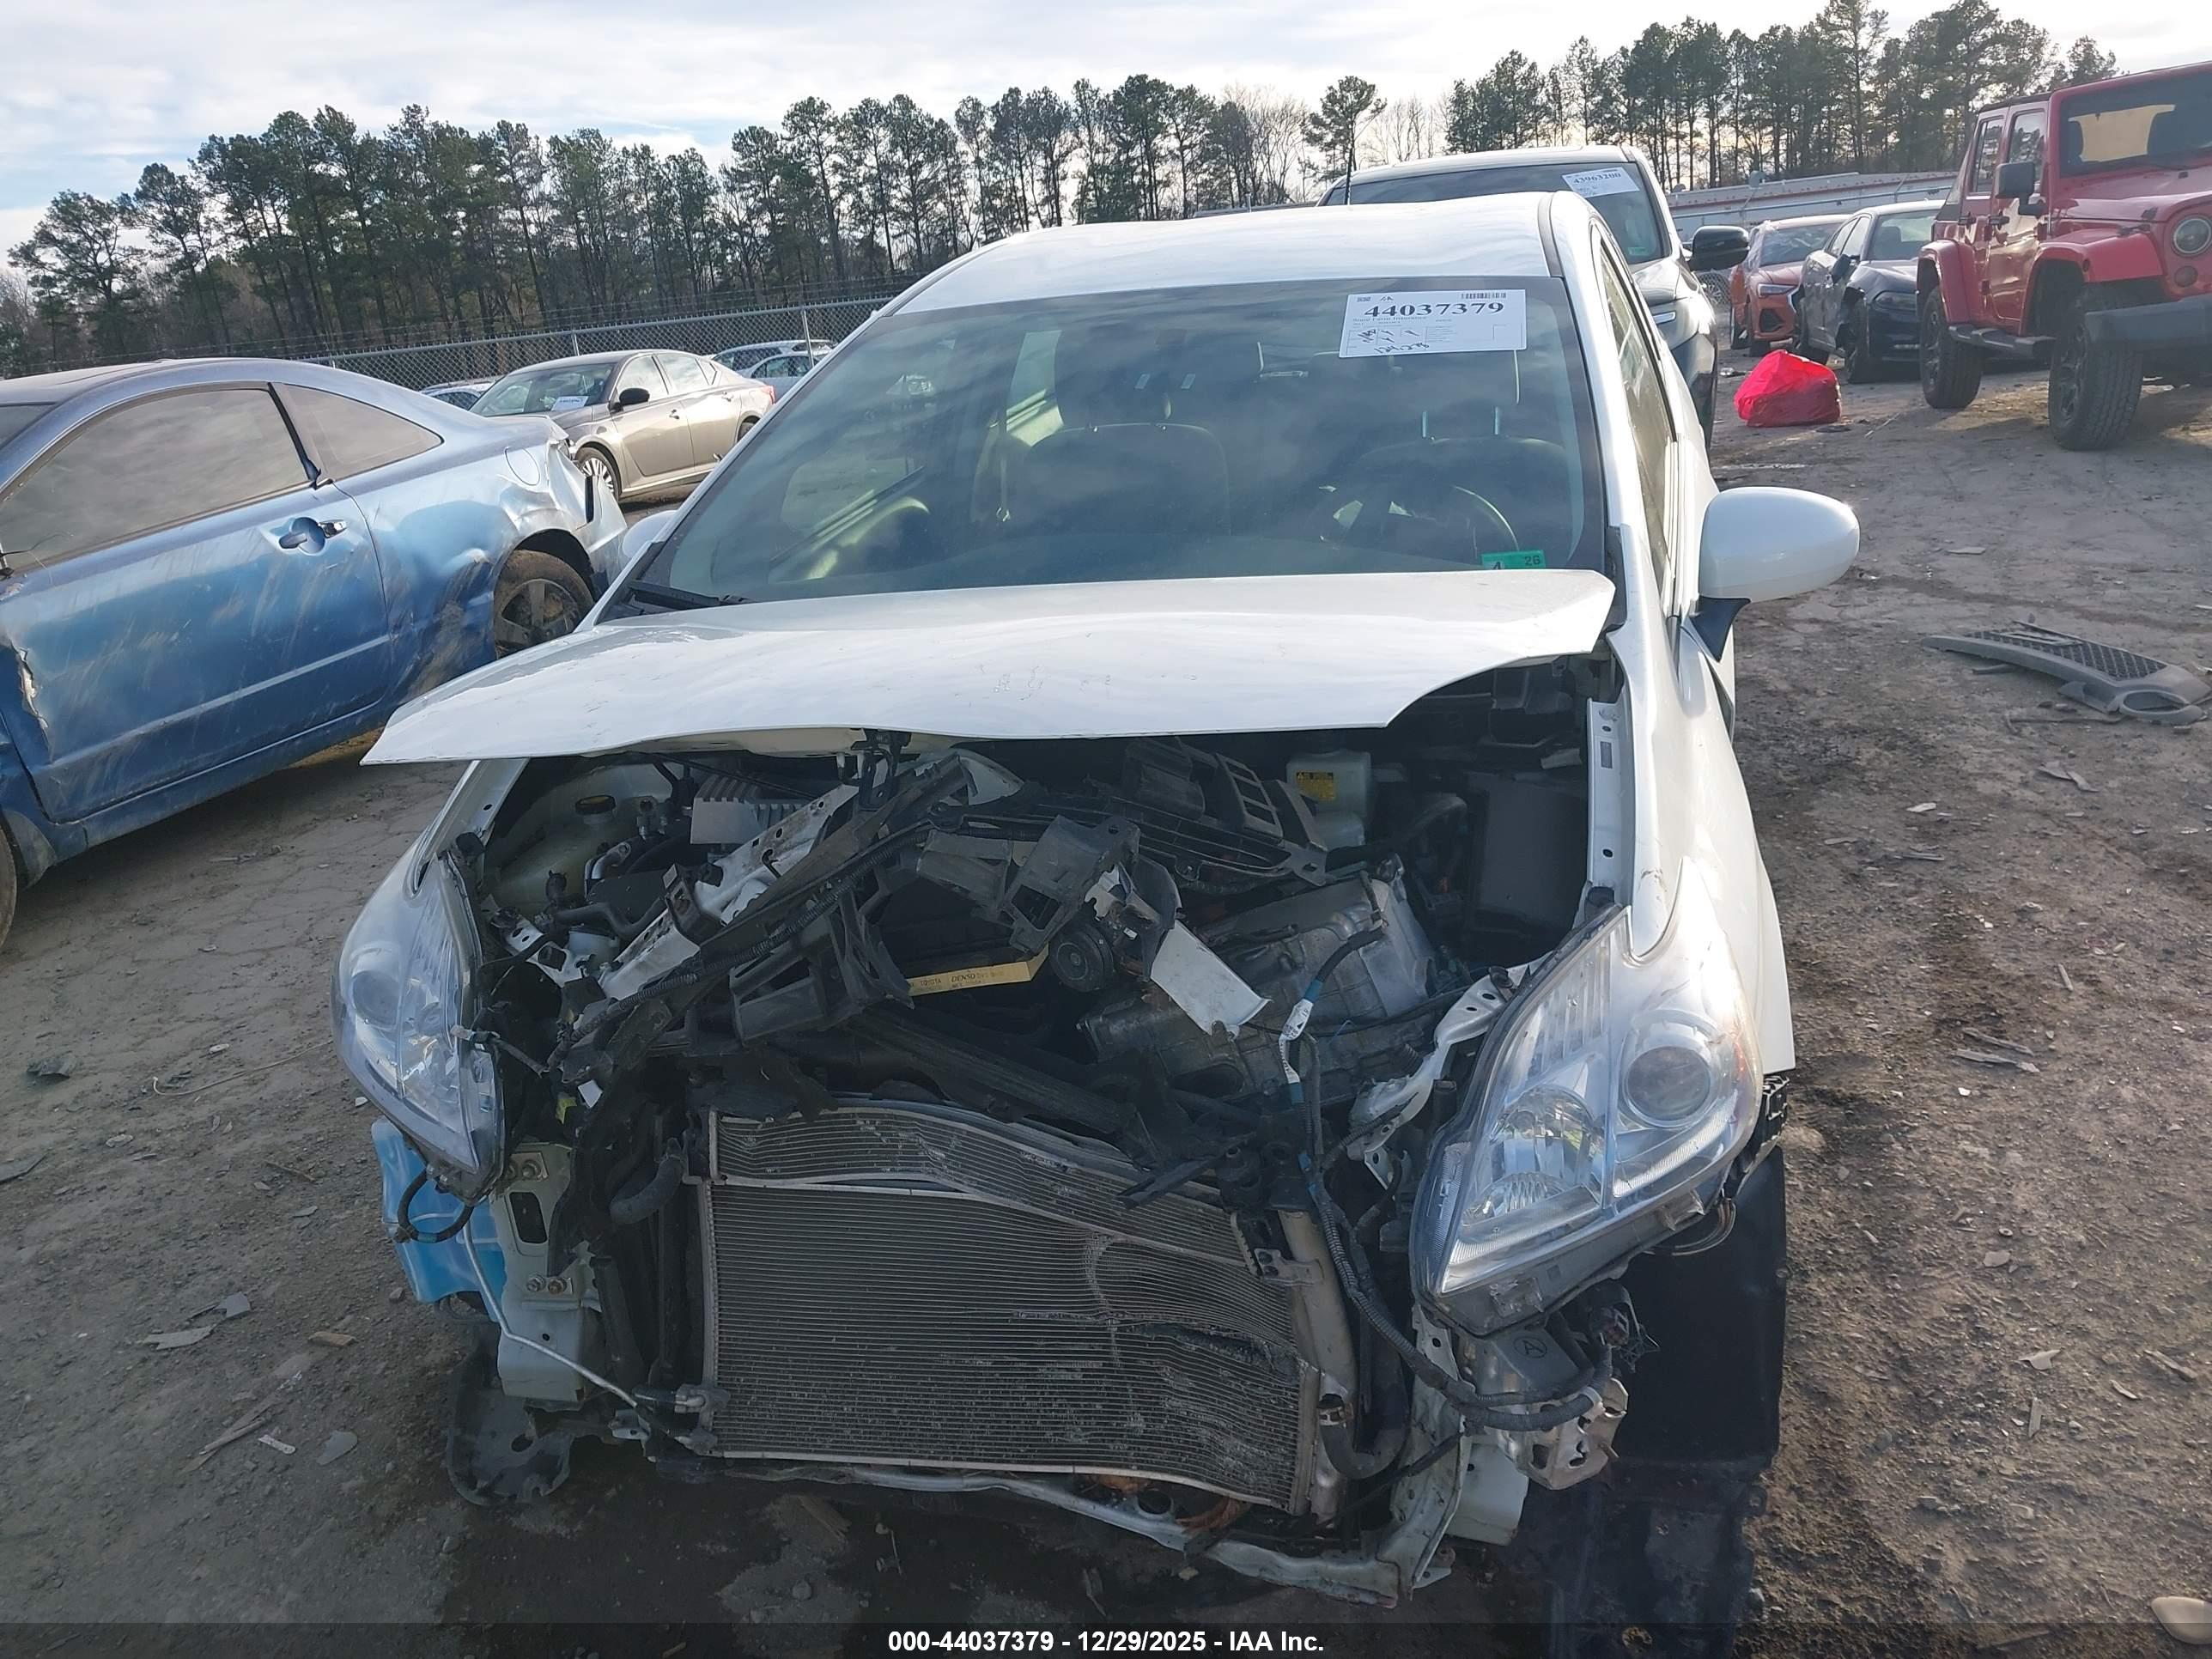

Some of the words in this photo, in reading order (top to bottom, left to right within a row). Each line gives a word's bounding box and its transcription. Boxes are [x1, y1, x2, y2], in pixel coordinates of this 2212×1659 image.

[1574, 173, 1621, 184] 43963200
[1364, 302, 1504, 317] 44037379
[1525, 556, 1540, 566] 26
[951, 973, 975, 983] DENSO
